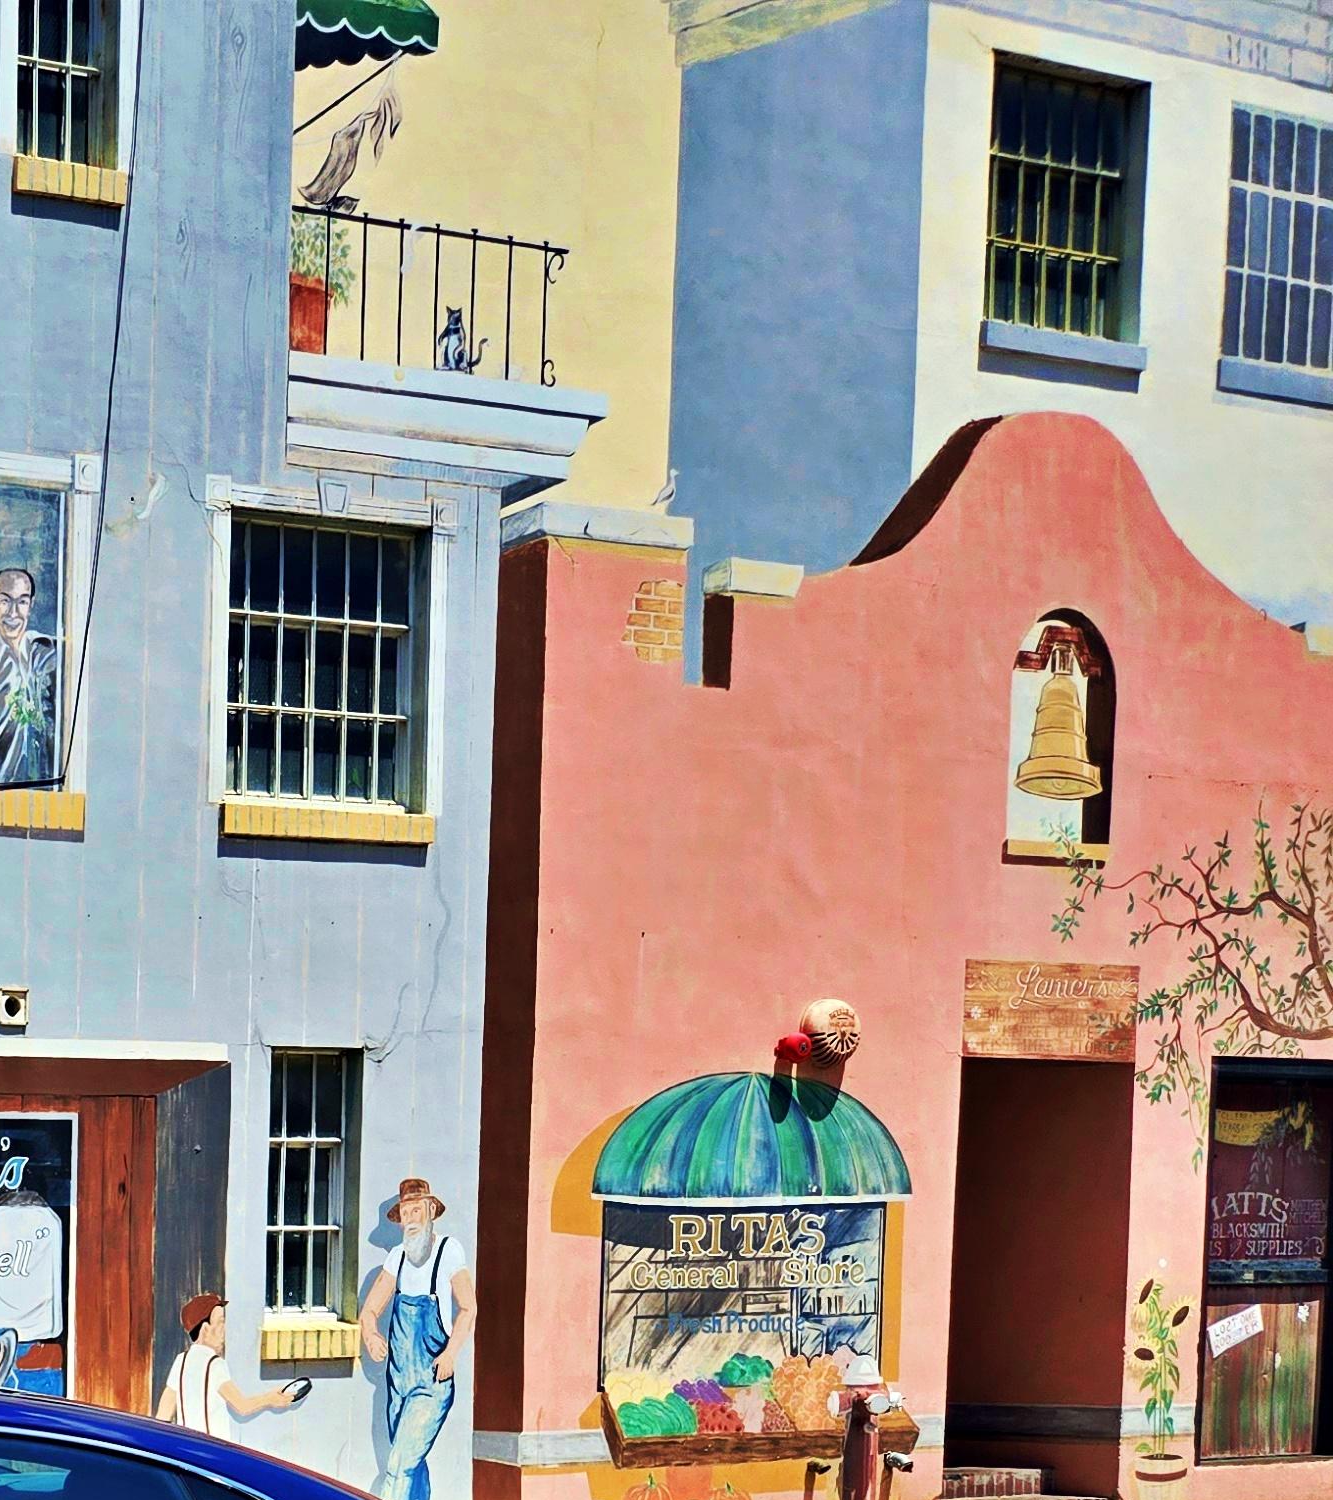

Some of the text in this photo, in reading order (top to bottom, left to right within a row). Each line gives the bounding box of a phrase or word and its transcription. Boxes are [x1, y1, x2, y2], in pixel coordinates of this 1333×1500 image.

[669, 1208, 827, 1257] RITA'S
[1212, 1223, 1285, 1239] BLACKSMITH
[1245, 1239, 1303, 1256] SUPPLIES
[630, 1259, 865, 1290] General Store
[668, 1312, 807, 1335] Fresh Produce
